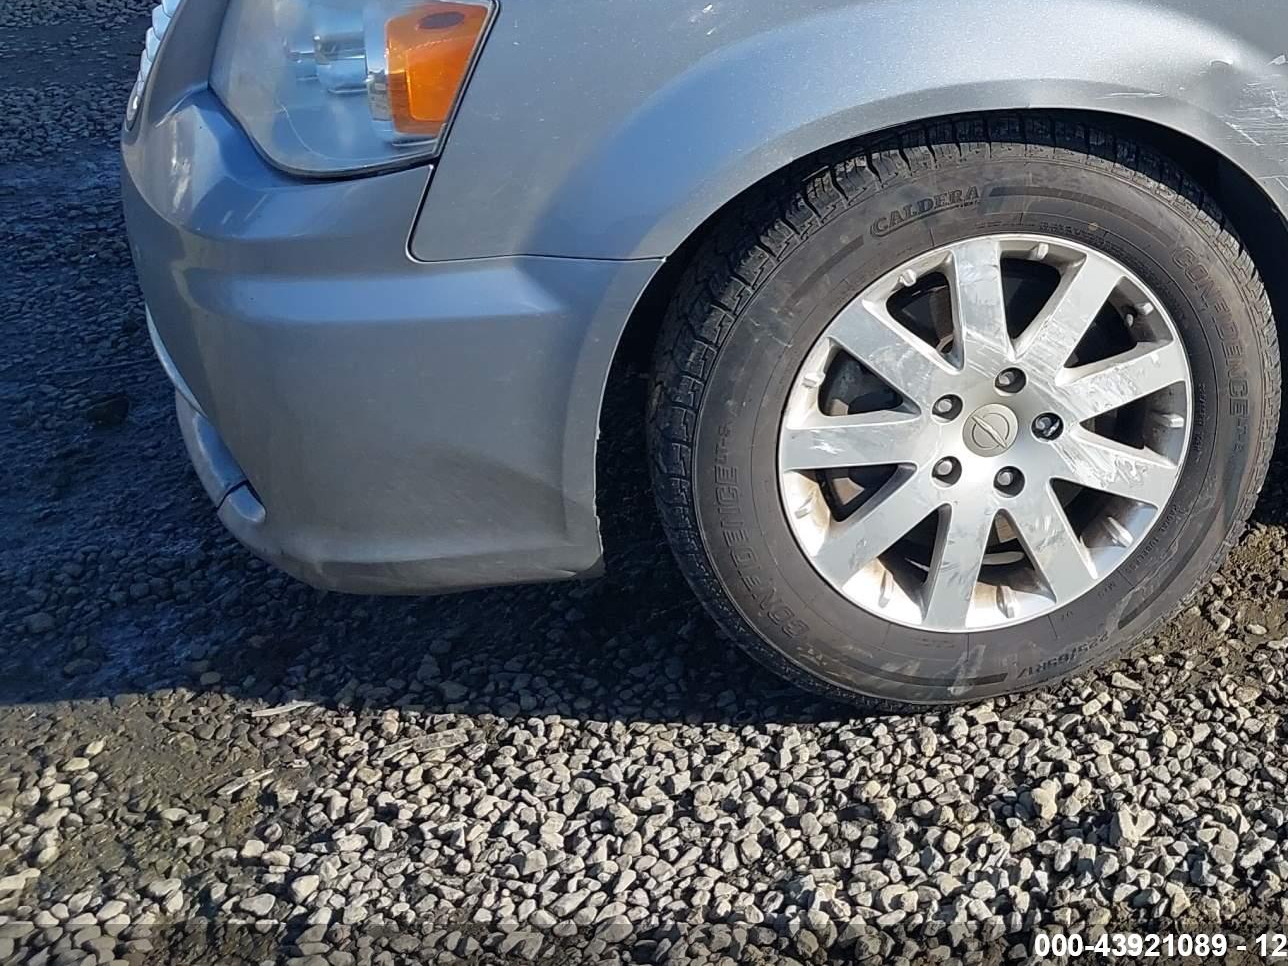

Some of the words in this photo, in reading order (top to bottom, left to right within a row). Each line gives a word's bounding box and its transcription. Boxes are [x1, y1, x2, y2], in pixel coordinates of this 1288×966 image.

[871, 185, 980, 234] CALDERA
[1171, 246, 1250, 416] CONFIDENCE
[713, 464, 810, 639] CONFIDENCE
